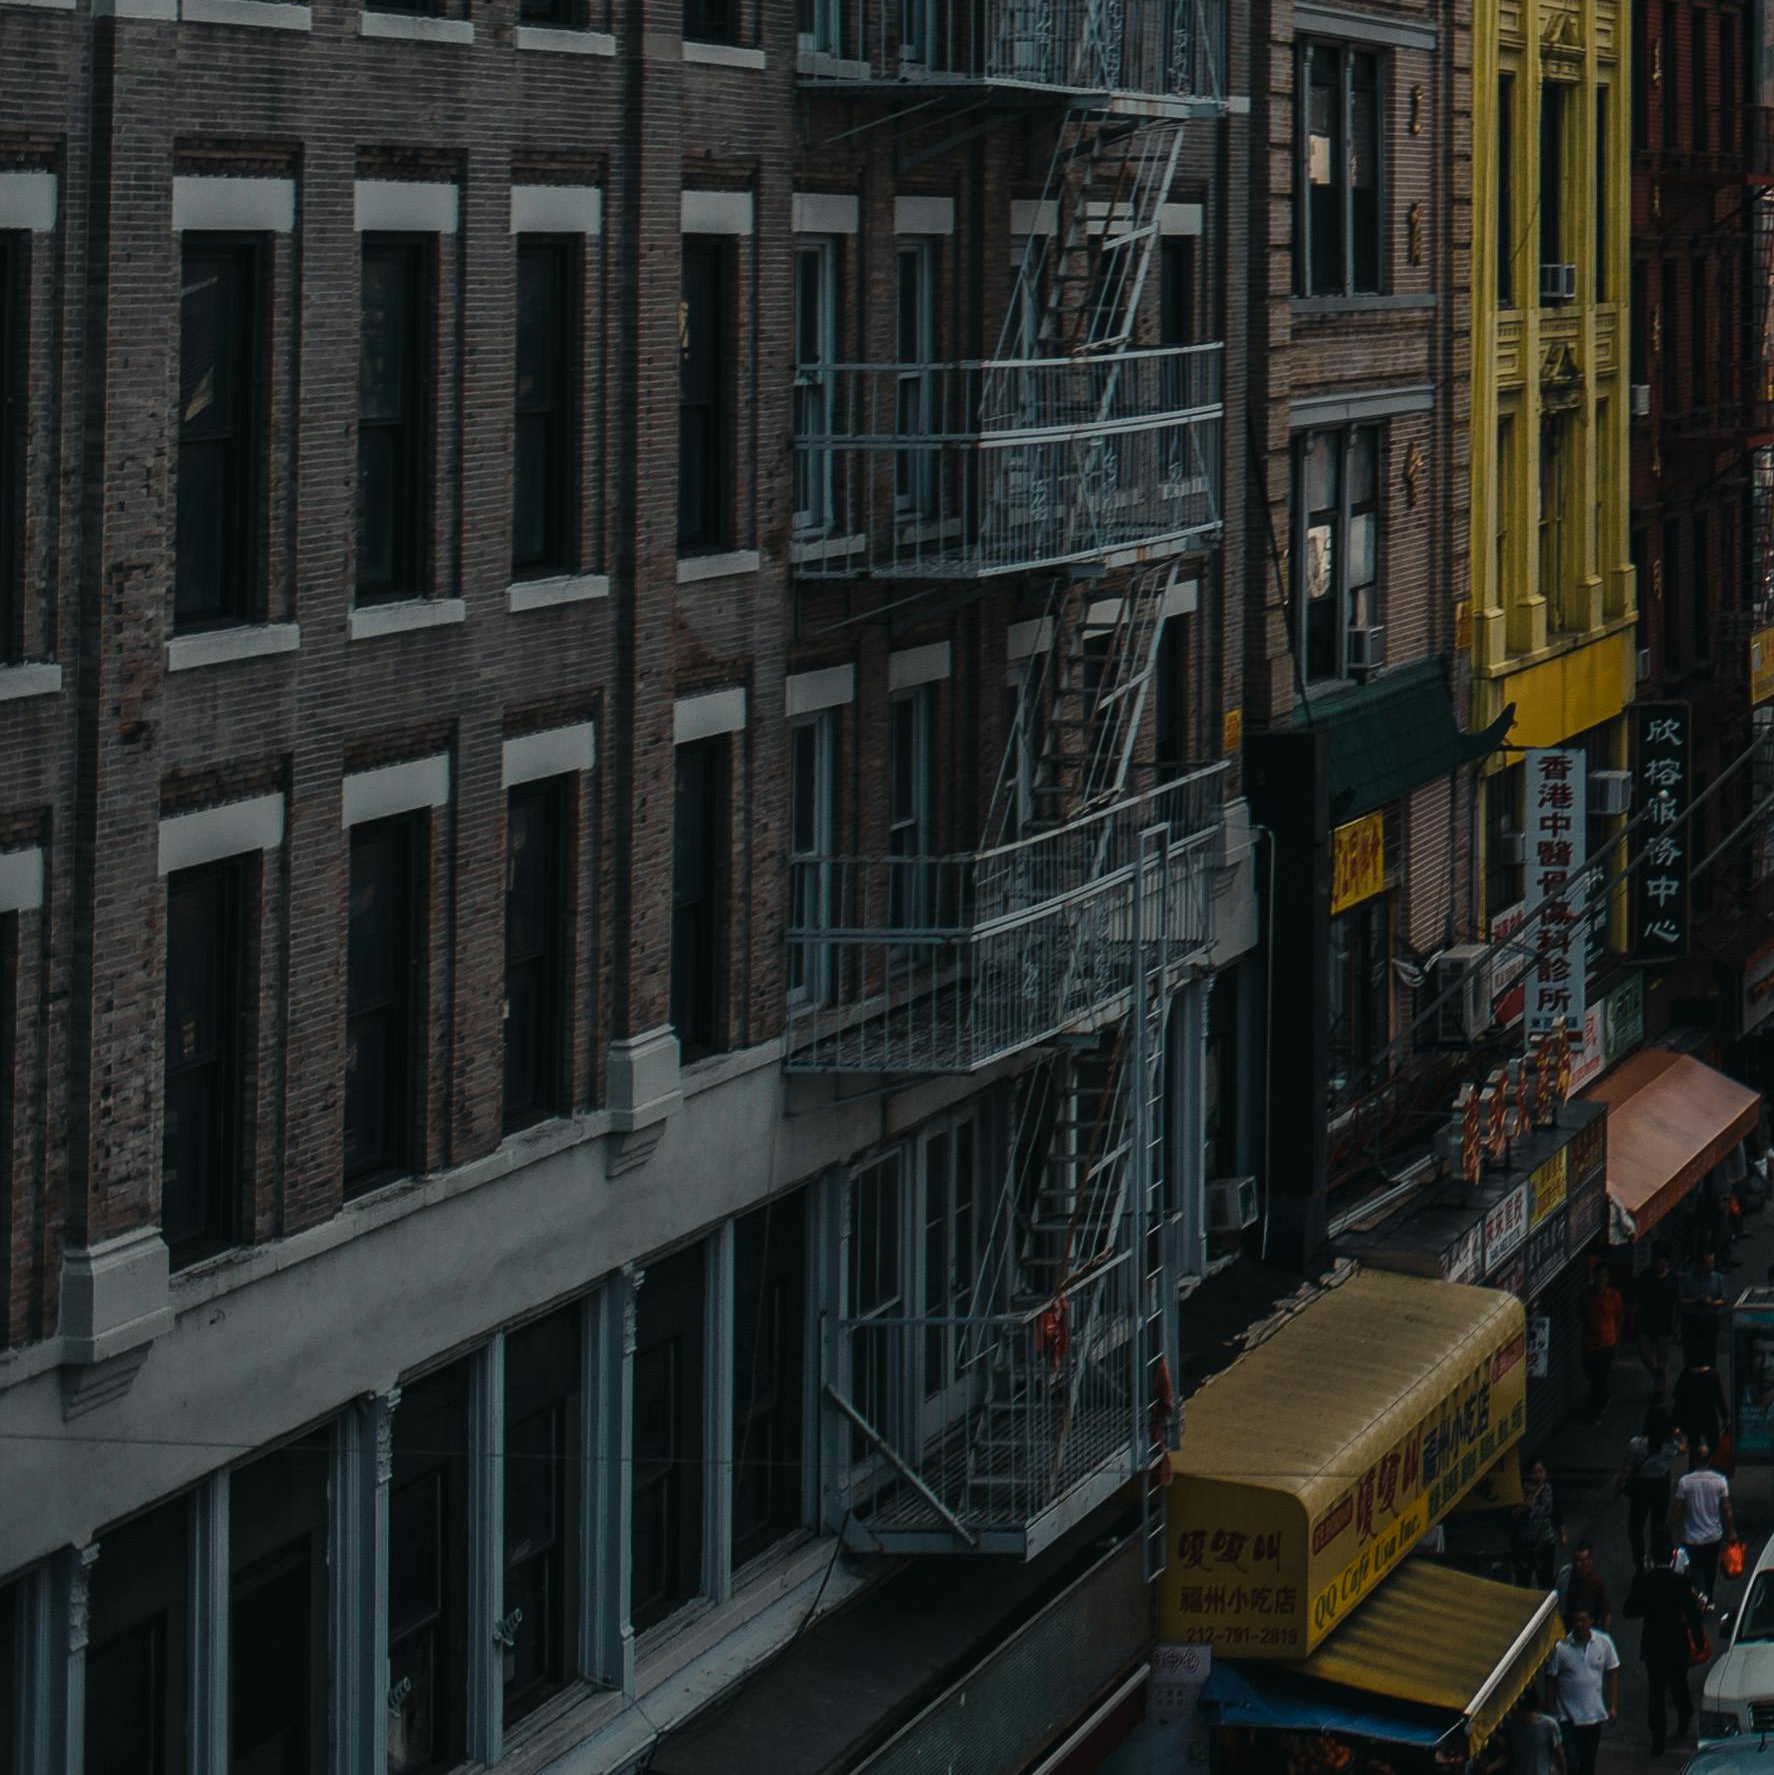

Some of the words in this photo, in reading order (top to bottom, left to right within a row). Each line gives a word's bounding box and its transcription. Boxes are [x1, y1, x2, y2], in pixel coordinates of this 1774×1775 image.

[1180, 1586, 1298, 1615] 福州小吃店
[1185, 1626, 1299, 1646] 212-791-2819
